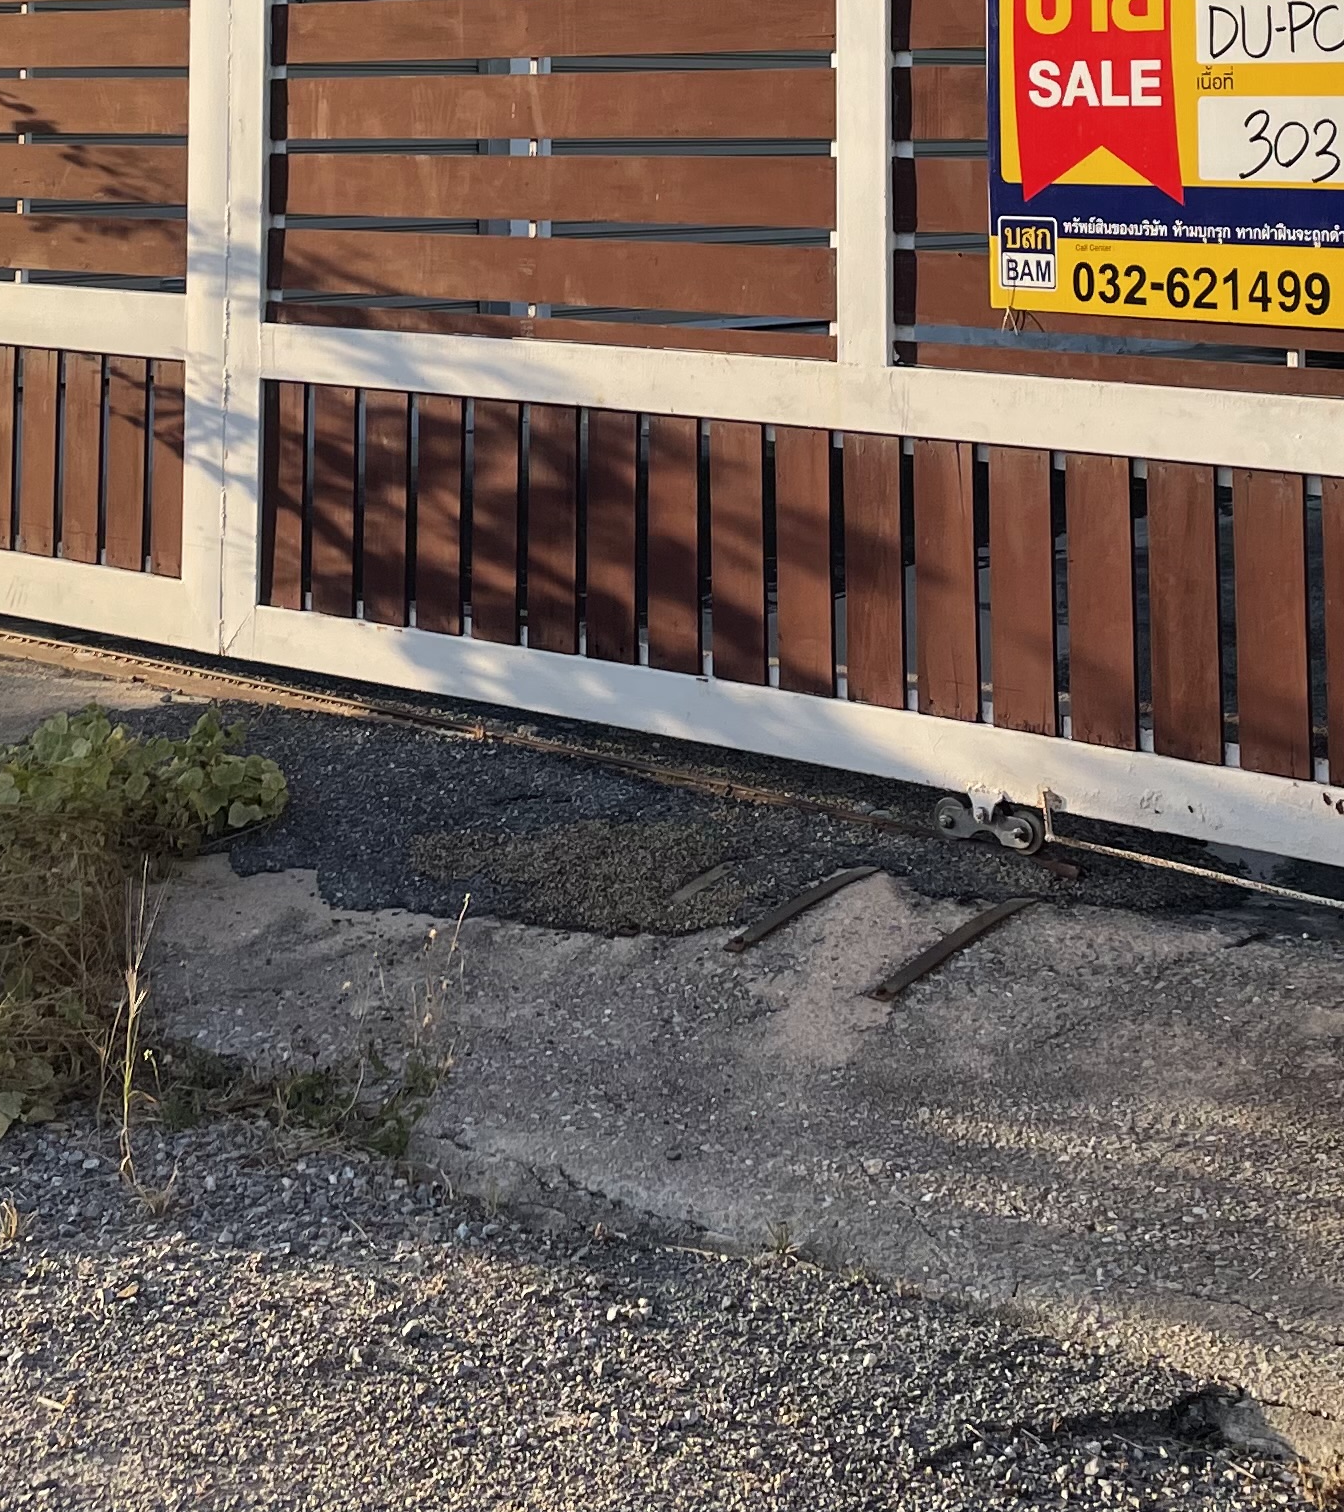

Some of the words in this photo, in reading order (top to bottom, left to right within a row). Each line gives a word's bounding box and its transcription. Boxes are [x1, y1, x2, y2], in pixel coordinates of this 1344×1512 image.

[1028, 59, 1162, 108] SALE
[1196, 65, 1234, 90] เนื้อที่
[1239, 109, 1341, 183] 303
[1004, 225, 1052, 251] บสก
[1062, 217, 1168, 237] ทรัพย์สินของบริษัท
[1172, 219, 1232, 245] ห้ามบุกรุก
[1007, 258, 1052, 283] BAM
[1072, 261, 1332, 316] 032-621499
